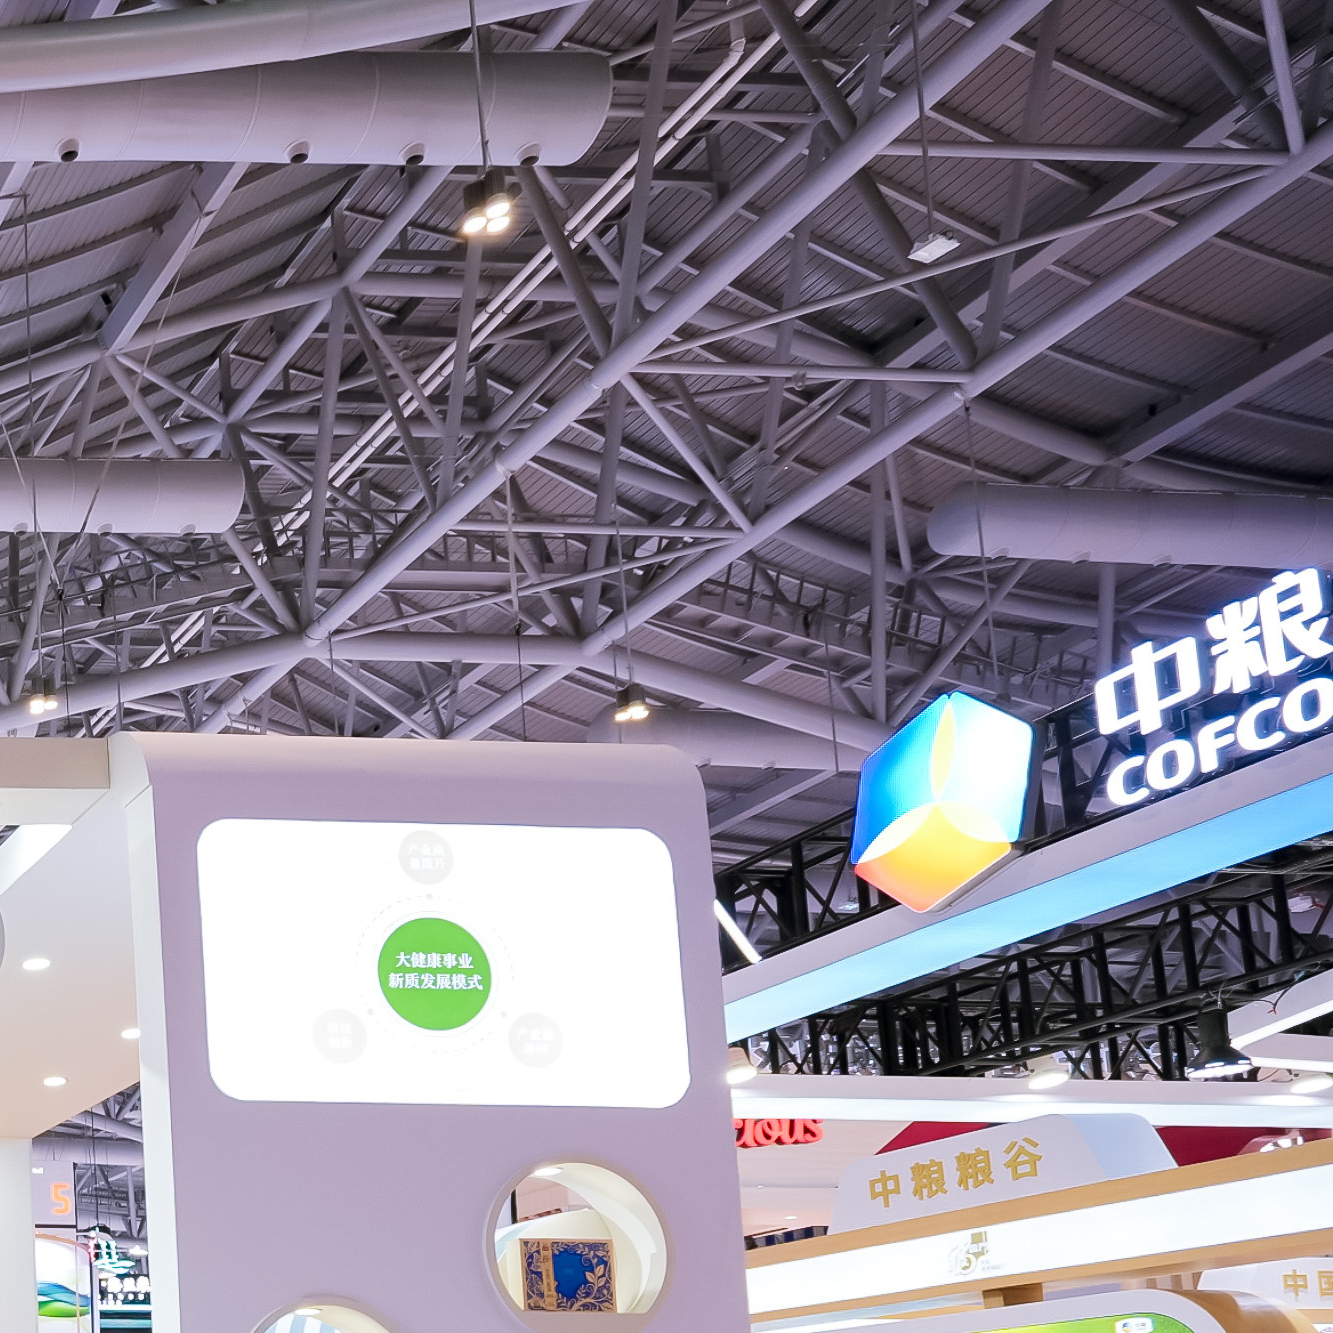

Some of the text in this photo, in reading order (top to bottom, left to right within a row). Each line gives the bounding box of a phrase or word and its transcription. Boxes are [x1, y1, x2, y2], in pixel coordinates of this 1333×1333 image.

[1095, 567, 1333, 736] 中粮
[1106, 677, 1333, 806] COFCO
[388, 973, 483, 991] 新质发展模式
[395, 951, 474, 970] 大健康事业
[51, 1182, 72, 1215] 5
[869, 1136, 1043, 1209] 中粮粮谷
